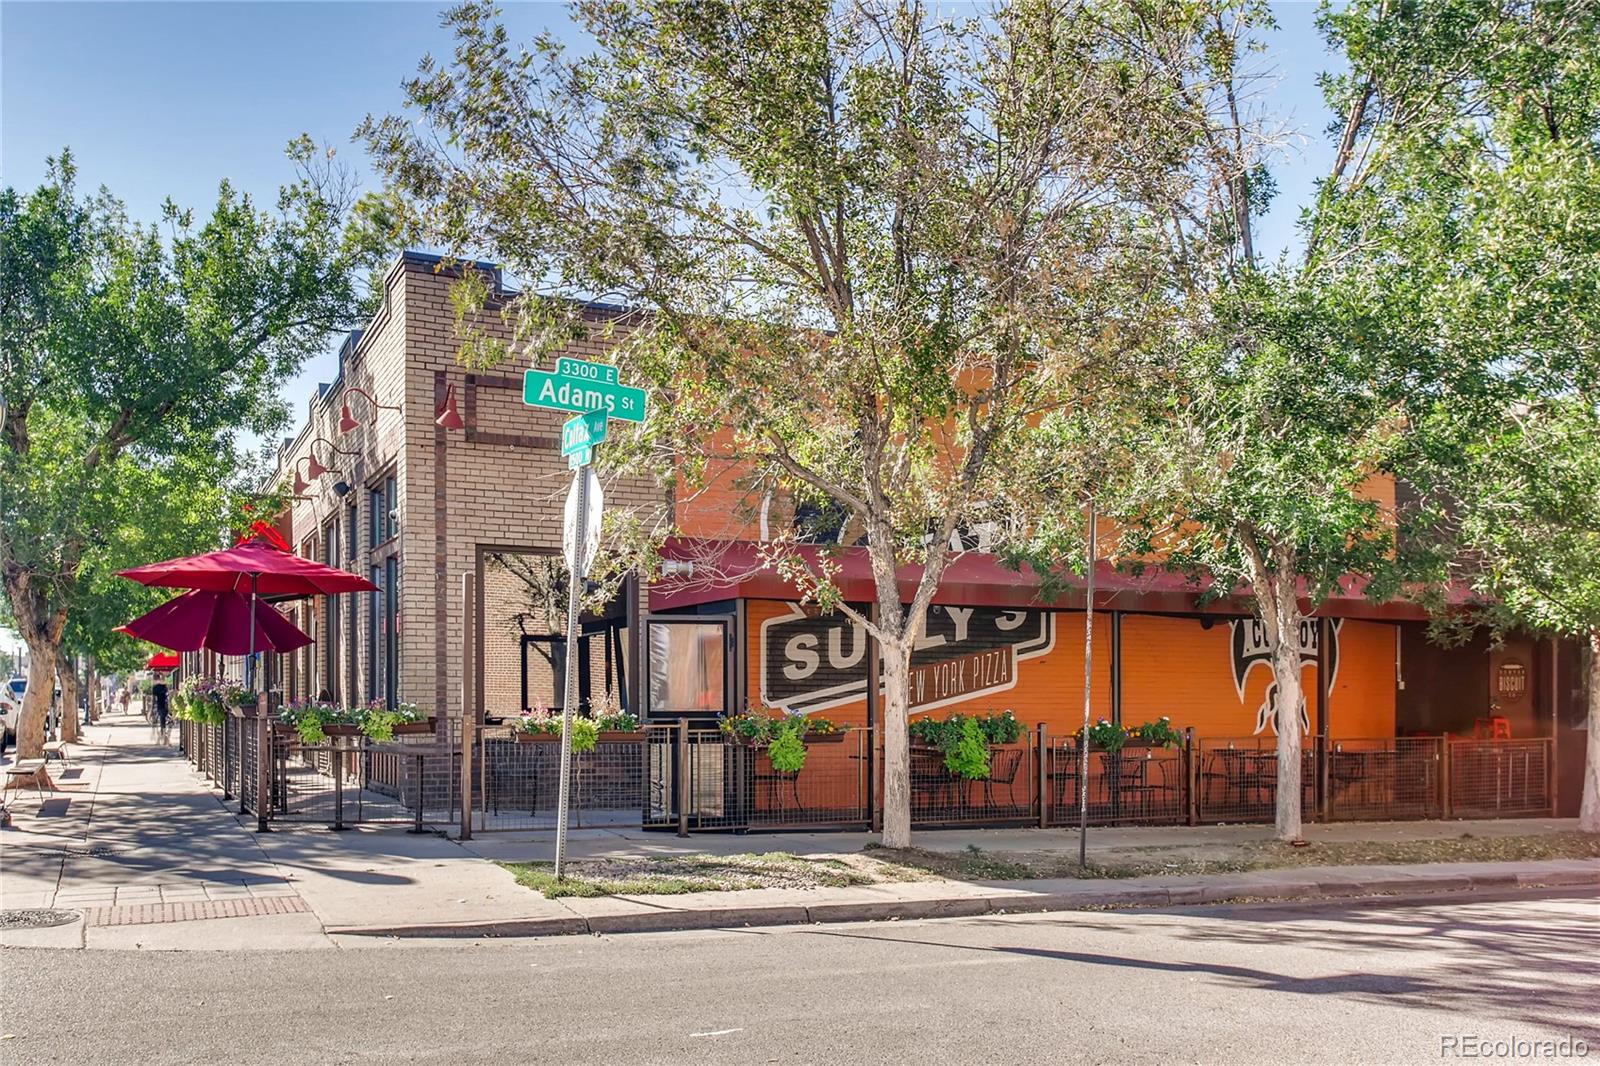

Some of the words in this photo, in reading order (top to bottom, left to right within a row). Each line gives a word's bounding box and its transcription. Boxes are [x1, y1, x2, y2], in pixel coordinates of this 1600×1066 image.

[562, 362, 598, 379] 3300
[606, 369, 614, 382] E
[539, 378, 615, 412] Adams
[621, 397, 634, 411] St
[908, 669, 926, 705] EW
[934, 659, 966, 699] YORK
[973, 650, 1007, 689] PIZZA
